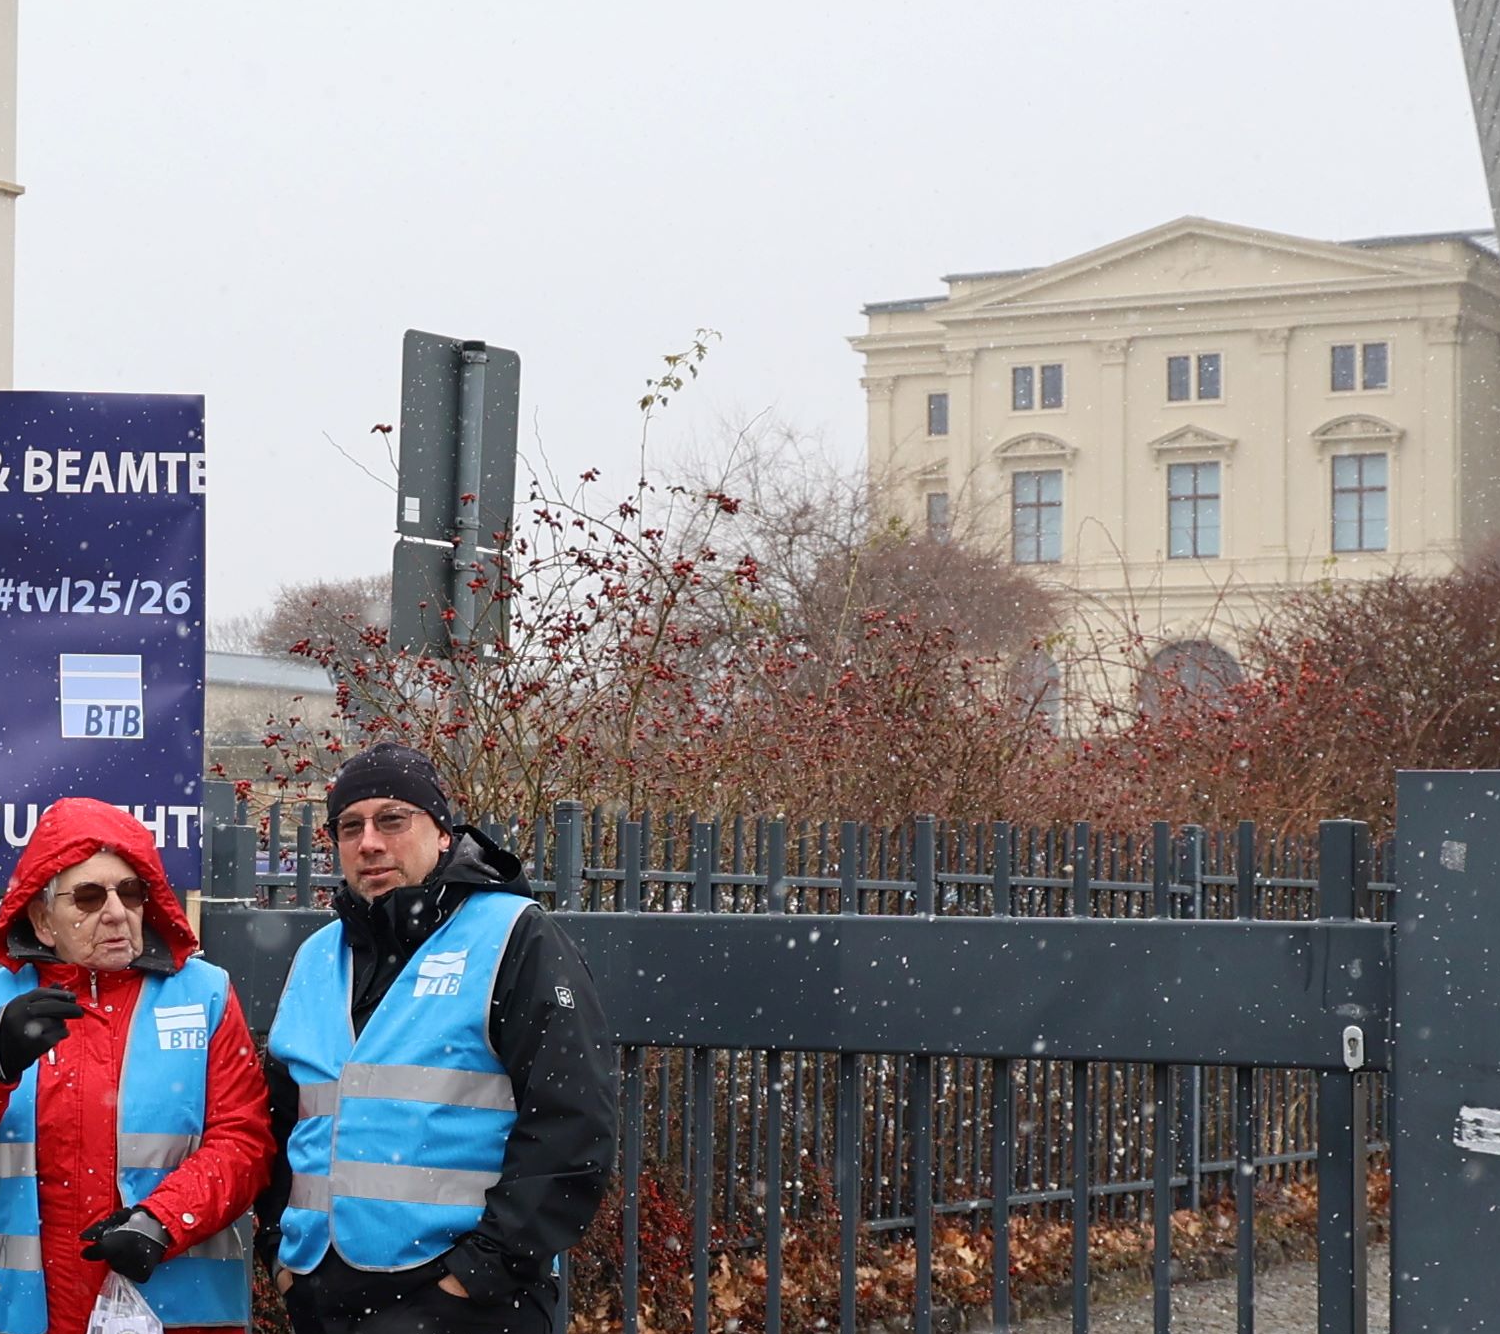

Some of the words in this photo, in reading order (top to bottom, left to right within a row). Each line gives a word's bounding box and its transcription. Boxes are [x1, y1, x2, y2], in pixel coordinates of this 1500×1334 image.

[23, 450, 205, 495] BEAMTE
[85, 705, 141, 737] BTB
[170, 1028, 207, 1049] BTB
